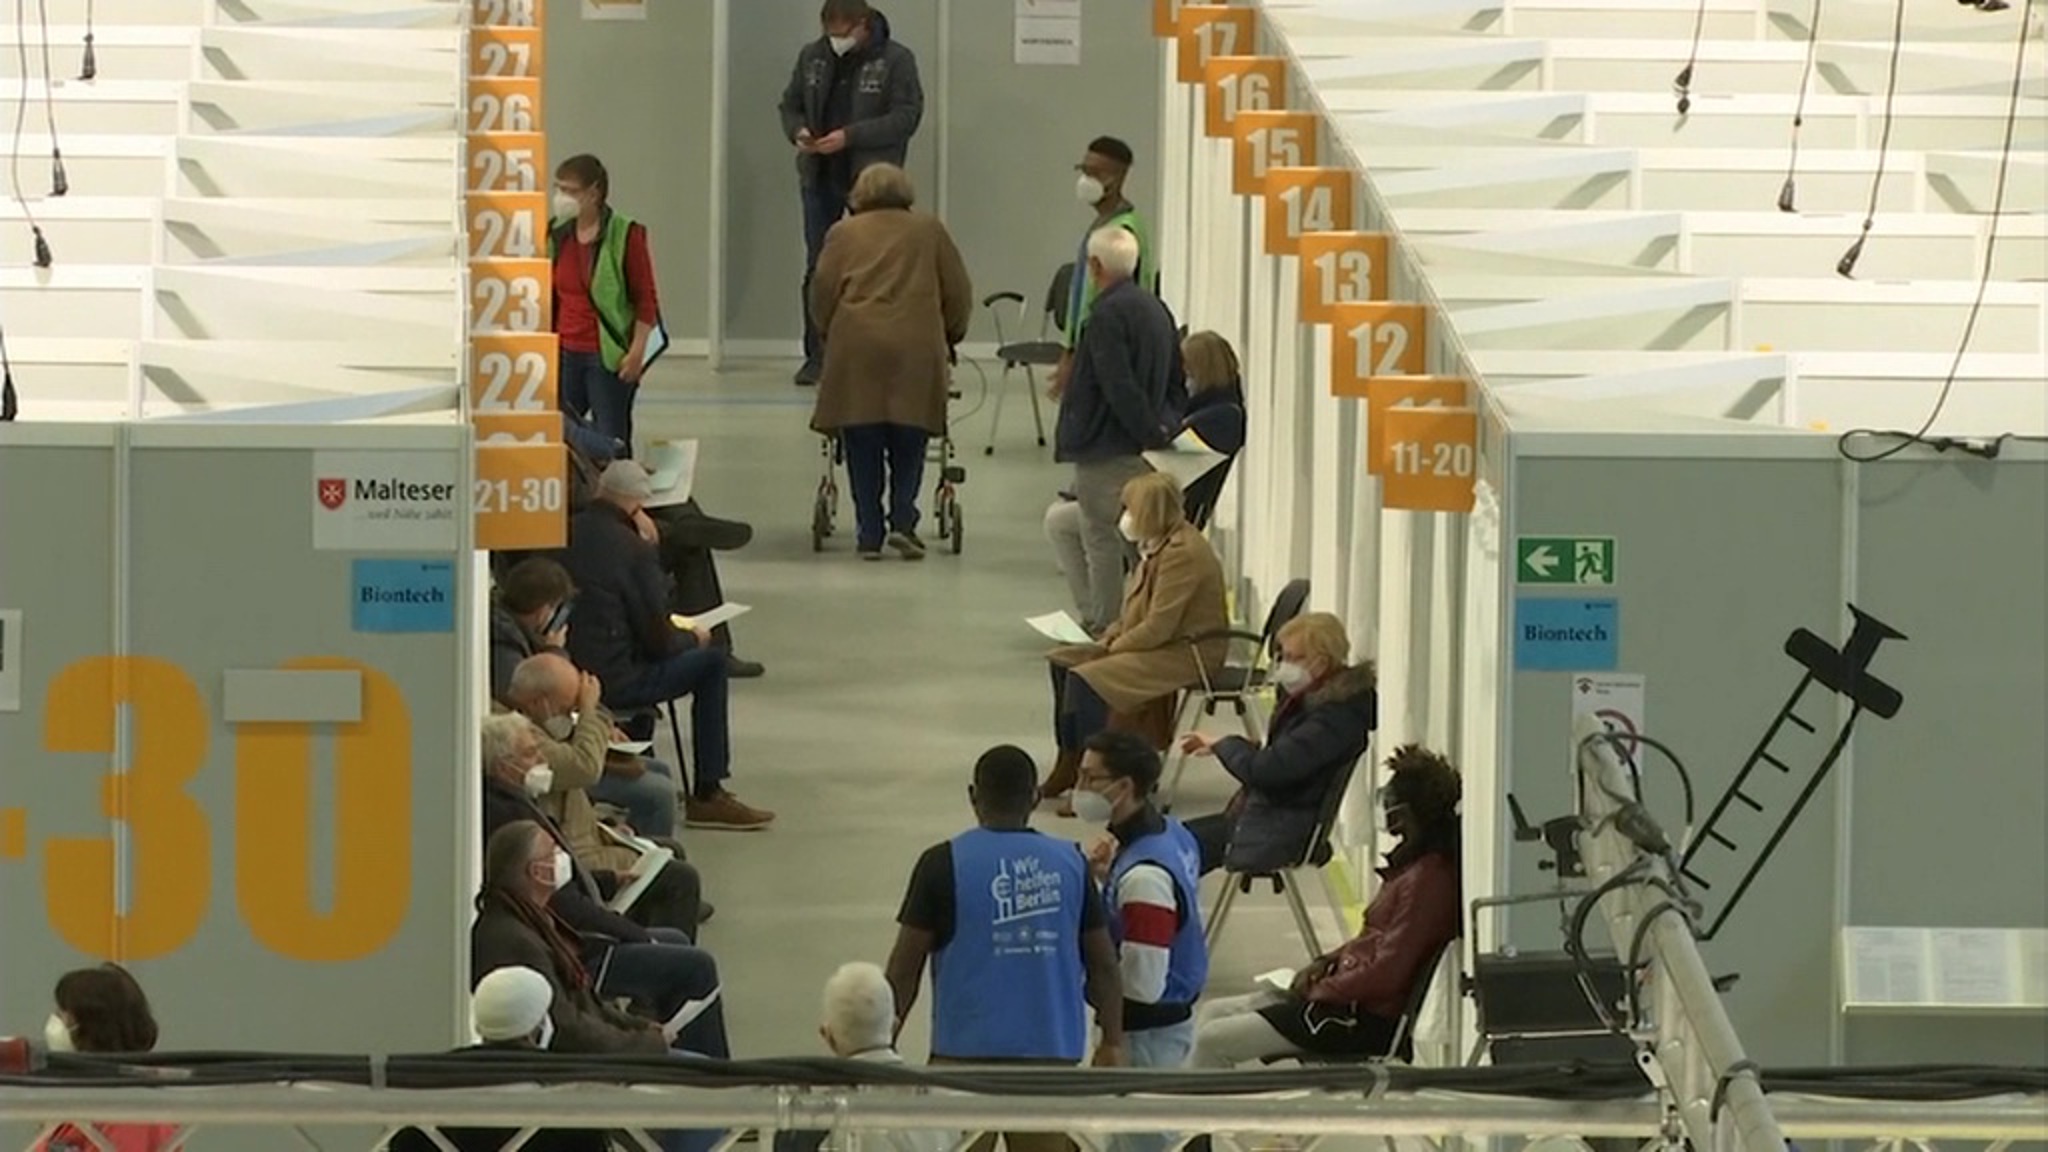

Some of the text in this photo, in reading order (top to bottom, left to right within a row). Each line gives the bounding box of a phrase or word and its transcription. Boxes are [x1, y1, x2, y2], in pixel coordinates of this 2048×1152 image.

[479, 0, 533, 26] 28
[480, 41, 530, 76] 27
[1192, 21, 1237, 68] 17
[472, 93, 532, 132] 26
[1217, 73, 1270, 122] 16
[474, 149, 535, 191] 25
[1246, 128, 1300, 178] 15
[1279, 185, 1334, 238] 14
[474, 209, 536, 257] 24
[1312, 250, 1371, 305] 13
[473, 277, 540, 331] 23
[1348, 321, 1409, 378] 12
[479, 352, 547, 411] 22
[1391, 441, 1474, 477] 11-20
[354, 477, 455, 501] Malteser
[474, 477, 562, 513] 21-30
[361, 586, 445, 603] Biontech
[1524, 624, 1607, 642] Biontech
[0, 654, 412, 962] 30
[1012, 857, 1039, 875] Wir
[1015, 870, 1061, 892] helfen
[1016, 889, 1061, 911] Berlin
